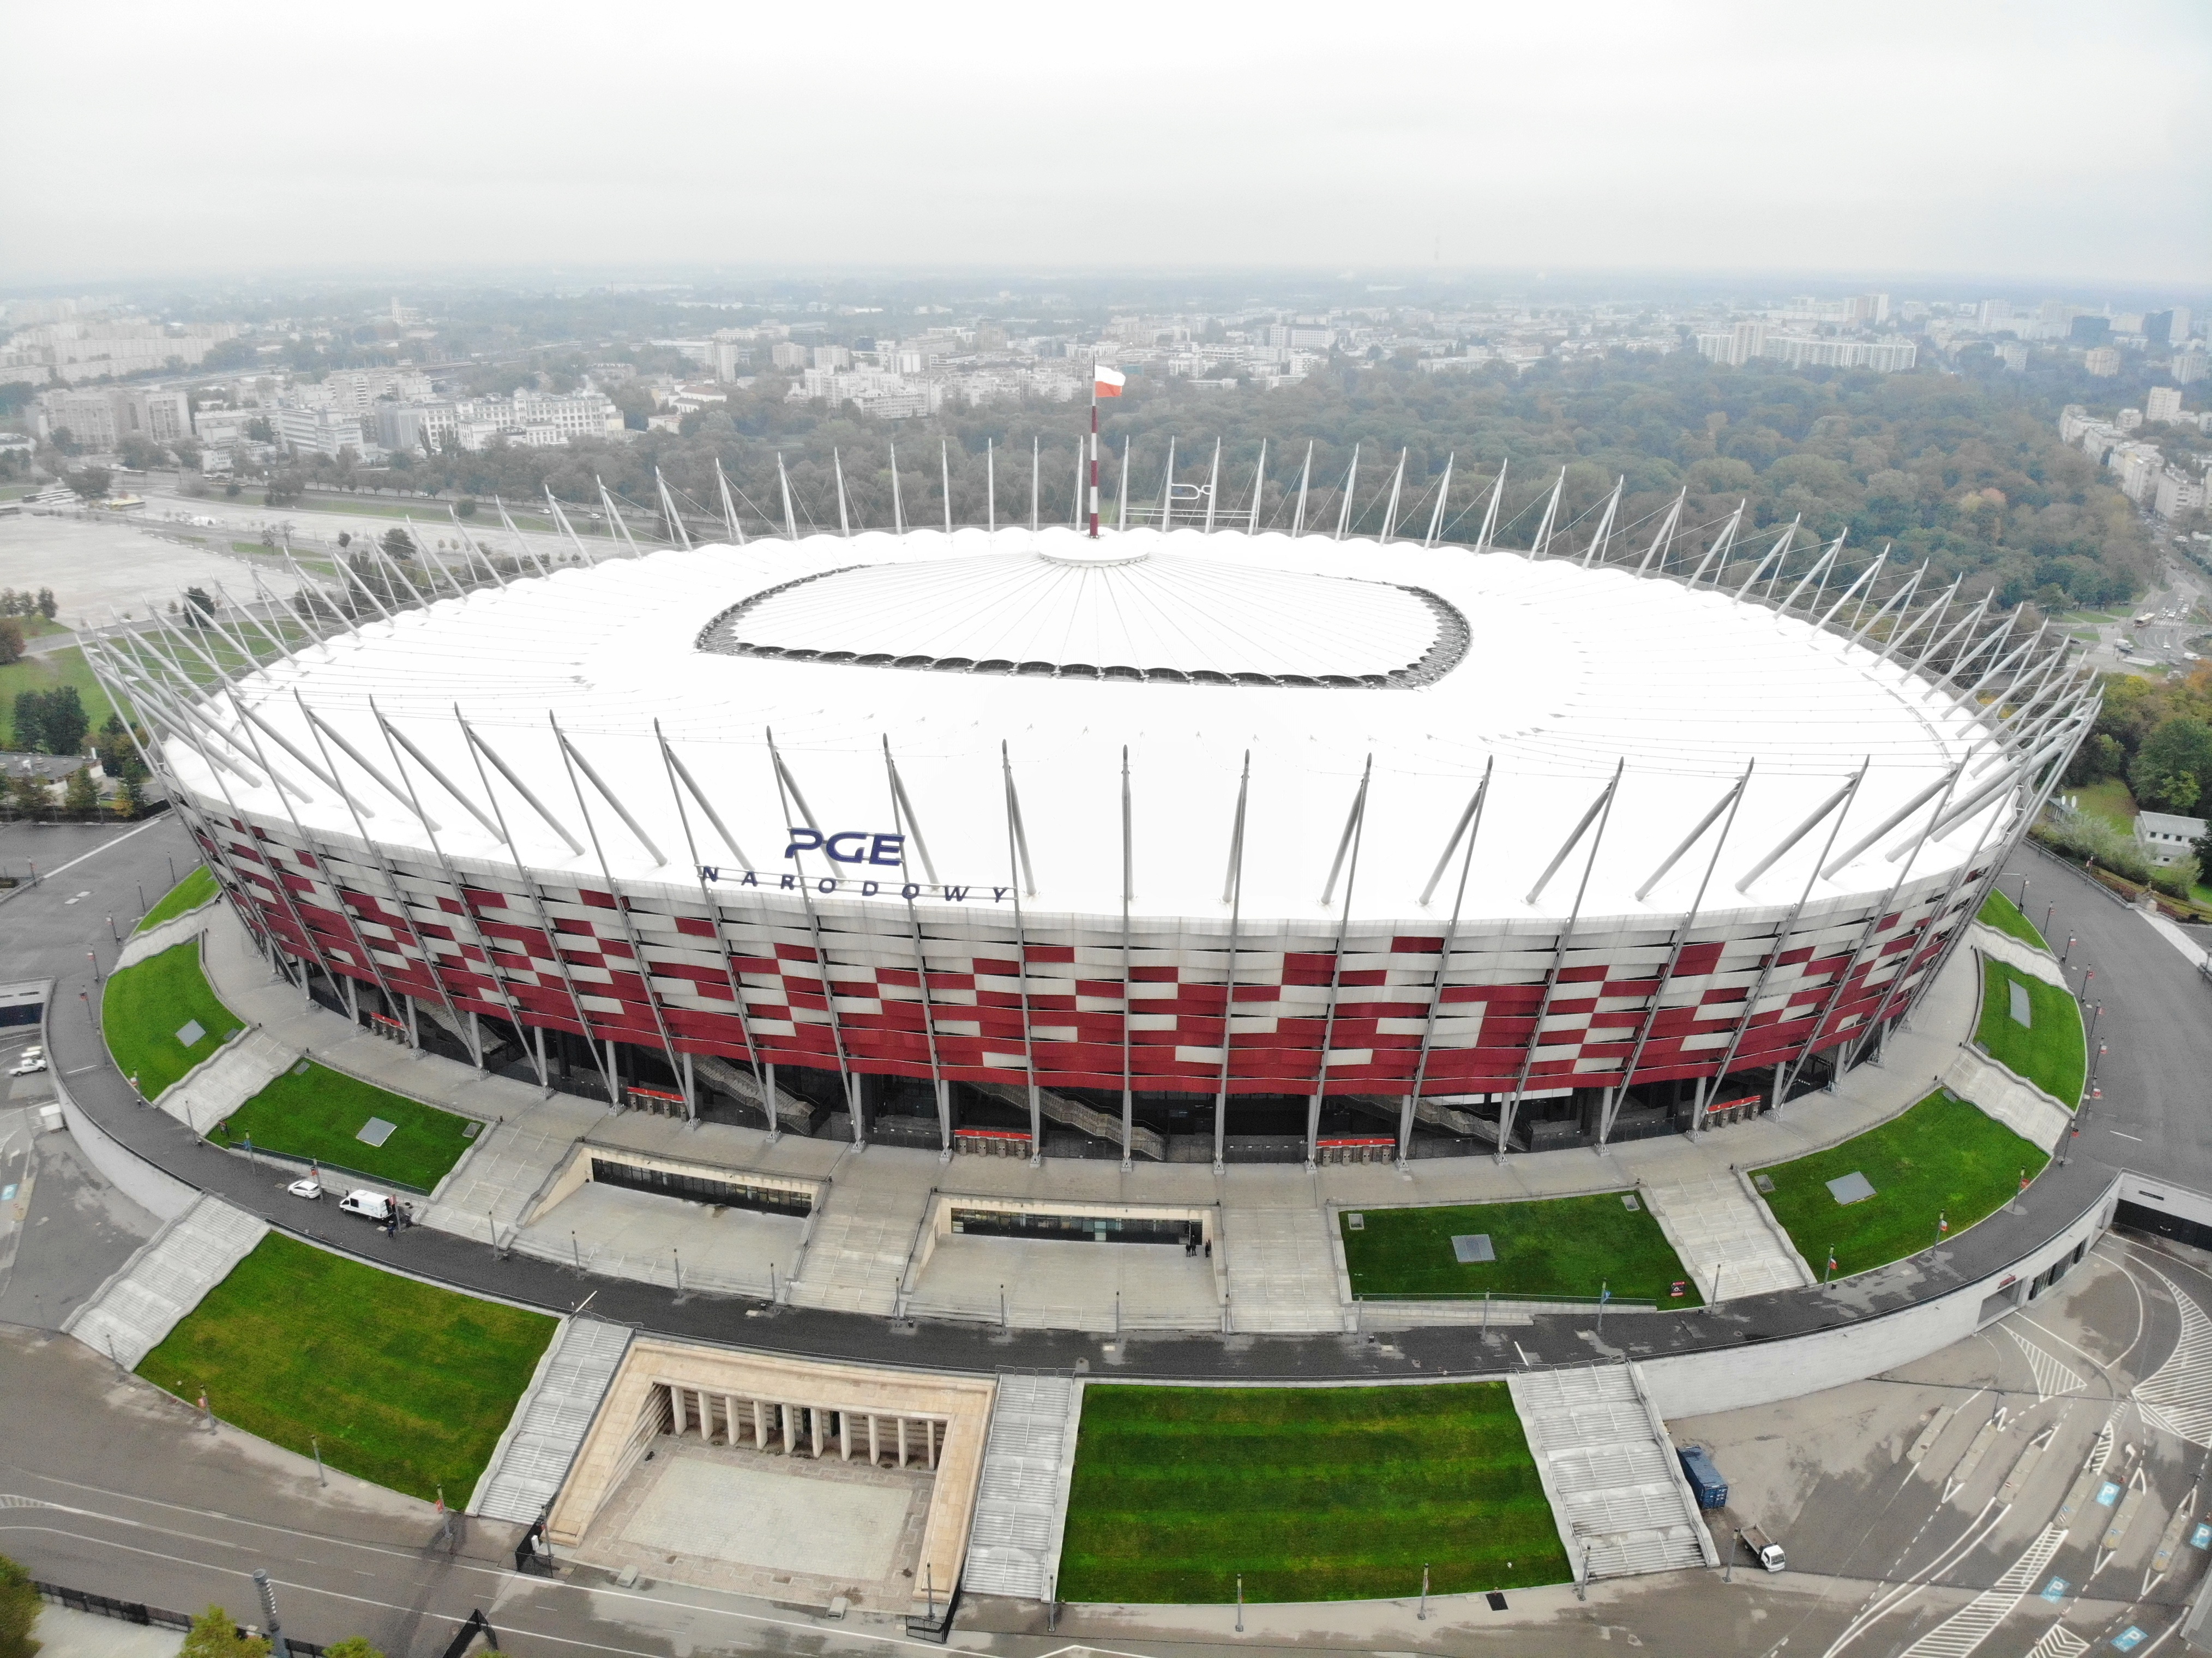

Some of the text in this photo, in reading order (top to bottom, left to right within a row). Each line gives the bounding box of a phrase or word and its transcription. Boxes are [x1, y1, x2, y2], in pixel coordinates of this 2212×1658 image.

[784, 827, 905, 866] PGE
[702, 866, 1007, 903] NARODOWY
[2103, 1485, 2115, 1496] P
[2198, 1528, 2210, 1539] P
[2049, 1581, 2064, 1593] P
[2123, 1630, 2140, 1640] P
